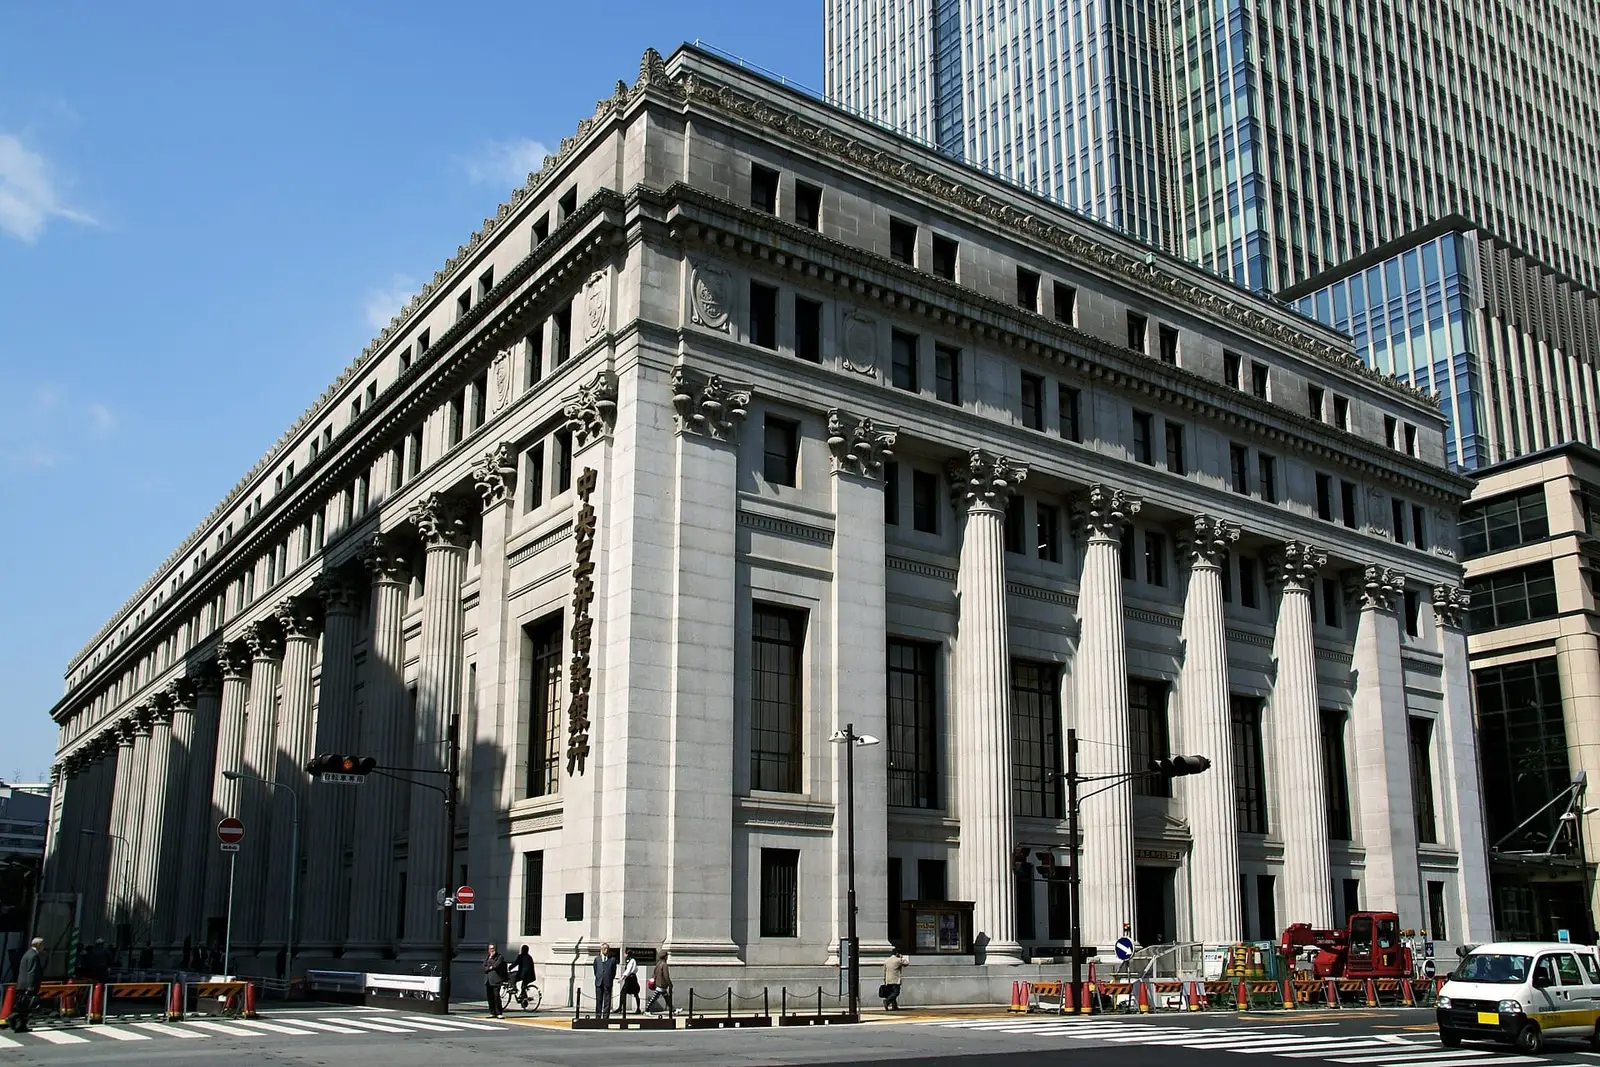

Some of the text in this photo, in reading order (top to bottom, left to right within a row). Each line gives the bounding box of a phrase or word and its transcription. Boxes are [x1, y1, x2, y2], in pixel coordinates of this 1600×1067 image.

[567, 467, 597, 777] 中央三井信託銀行
[325, 774, 362, 782] 自転車専用
